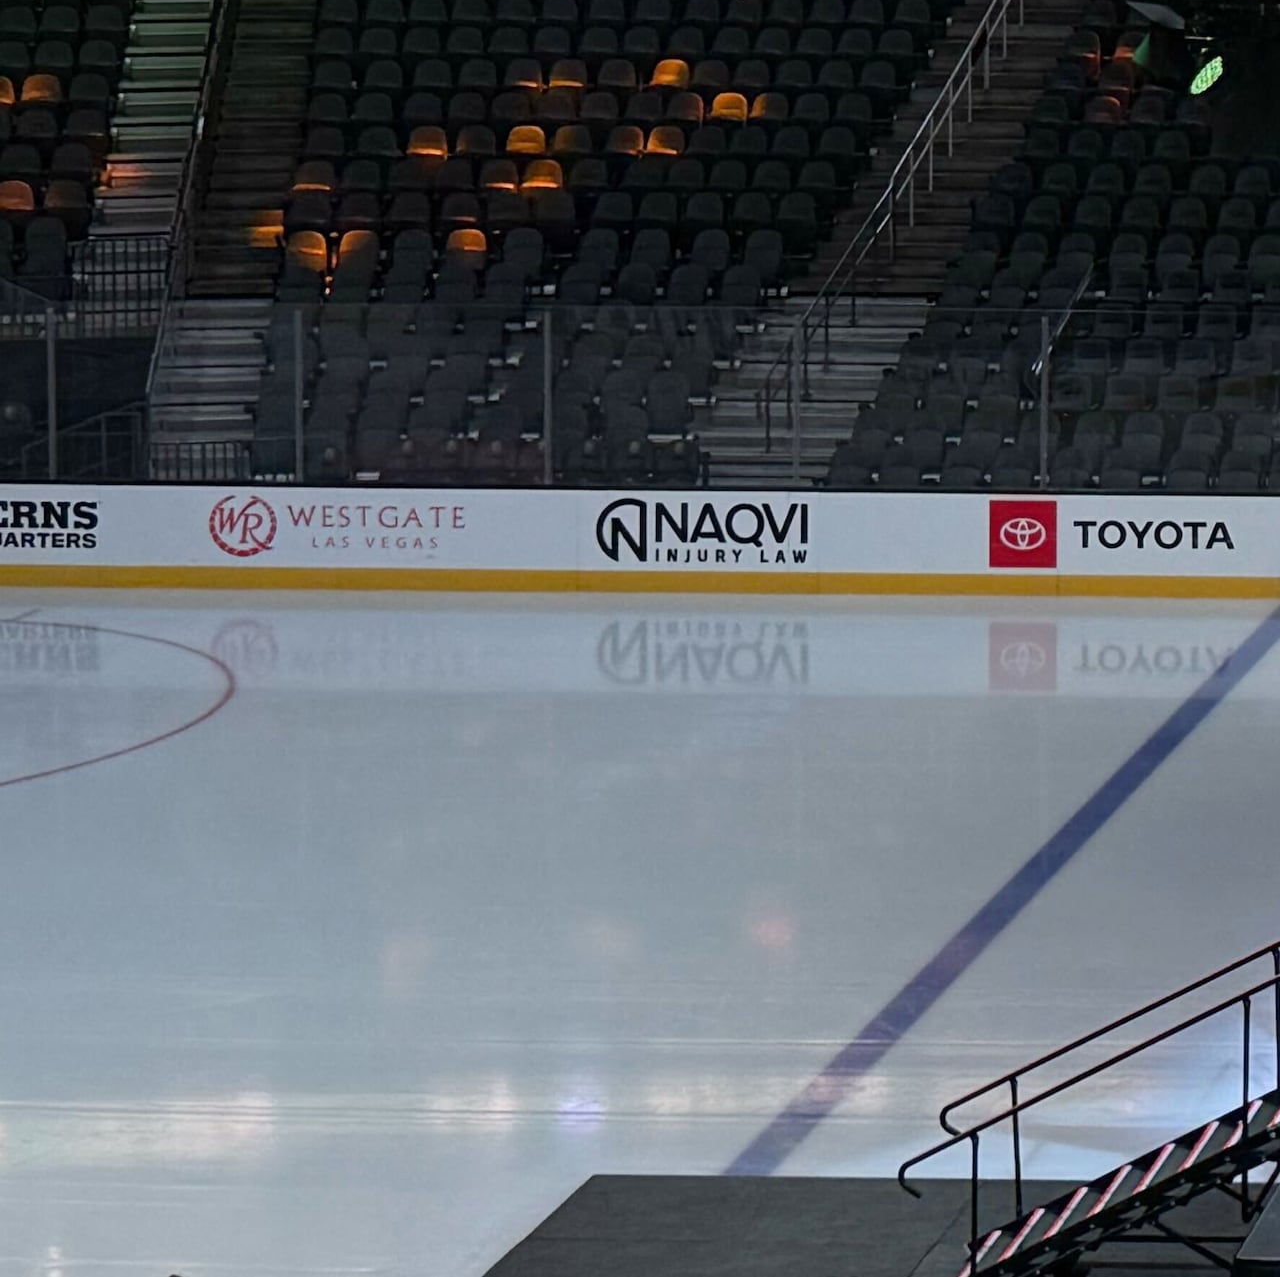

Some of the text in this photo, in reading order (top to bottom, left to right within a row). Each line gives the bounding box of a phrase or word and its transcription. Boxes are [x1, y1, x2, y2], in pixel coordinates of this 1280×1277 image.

[287, 504, 467, 530] WESTGATE
[654, 502, 809, 547] NAQVI
[0, 532, 97, 549] ARTERS
[311, 536, 440, 550] LAS VEGAS
[1072, 519, 1236, 552] TOYOTA
[655, 548, 808, 564] INJURY LAW
